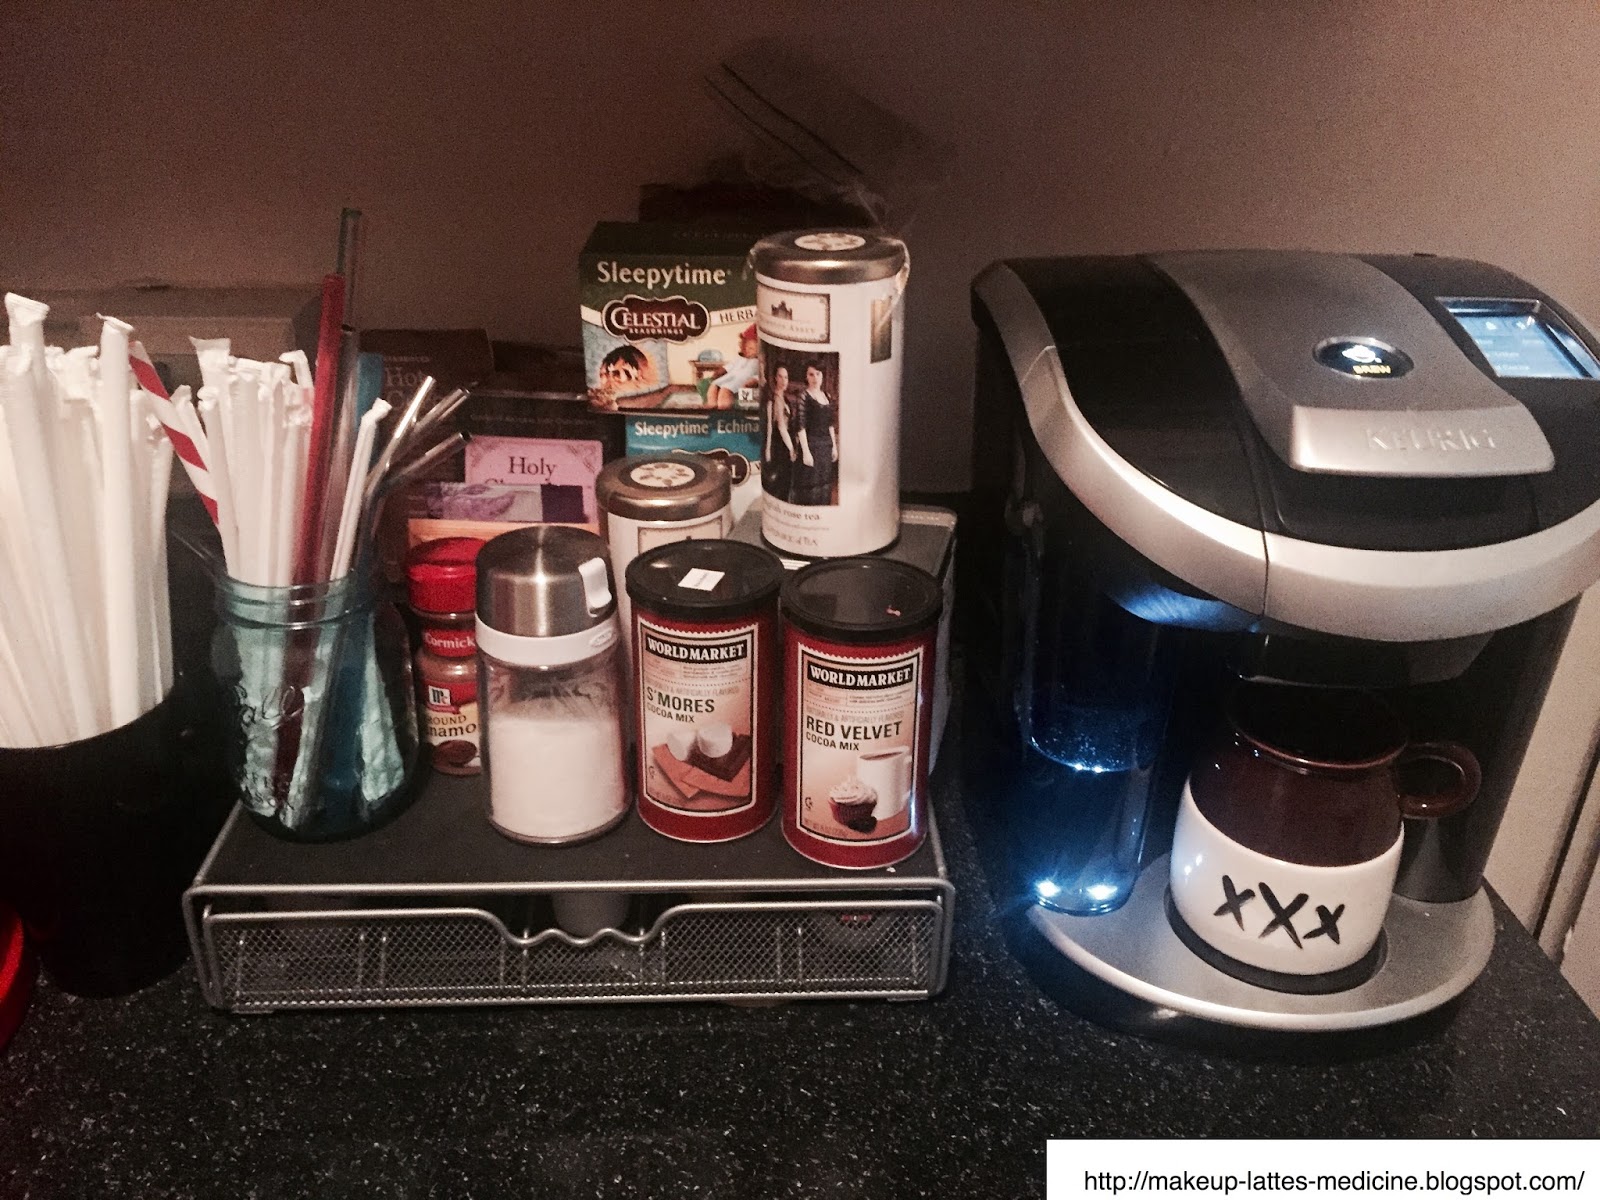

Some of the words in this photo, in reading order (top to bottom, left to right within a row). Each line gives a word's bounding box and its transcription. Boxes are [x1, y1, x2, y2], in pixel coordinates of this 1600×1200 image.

[597, 260, 727, 290] Sleepytime
[610, 306, 702, 330] CELESTIAL
[719, 309, 754, 324] HERB
[634, 420, 709, 439] Sleepytime
[717, 419, 760, 434] Echina
[508, 455, 556, 481] Holy
[424, 631, 476, 649] Cormick
[646, 686, 715, 713] S'MORES
[426, 715, 467, 726] ROUND
[646, 702, 673, 720] COCOA
[675, 713, 695, 723] MIX
[428, 723, 477, 737] namo
[806, 715, 835, 737] RED
[840, 720, 903, 740] VELVET
[806, 731, 837, 749] COCOA
[839, 741, 860, 752] MIX
